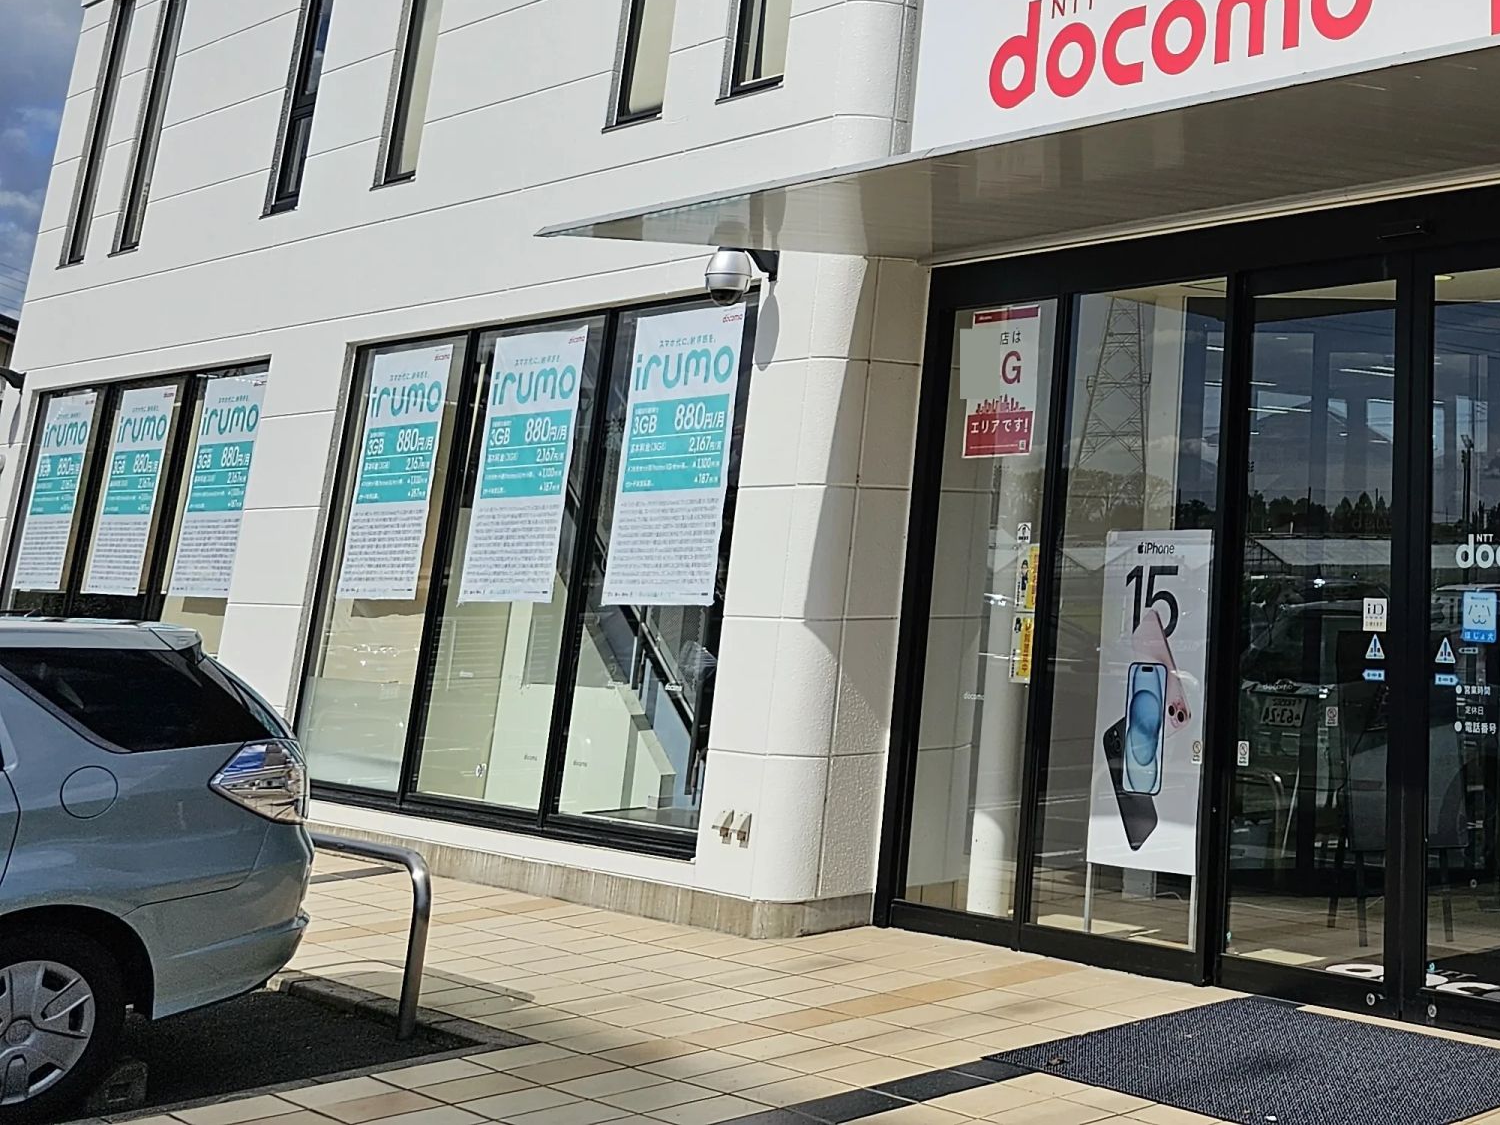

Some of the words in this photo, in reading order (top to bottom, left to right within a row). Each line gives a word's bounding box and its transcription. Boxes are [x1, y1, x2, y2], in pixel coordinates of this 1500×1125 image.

[635, 345, 734, 391] irumo
[492, 365, 576, 405] irumo
[371, 380, 442, 417] irumo
[117, 415, 167, 443] irumo
[201, 404, 259, 435] irumo
[633, 415, 657, 434] 3GB
[674, 402, 725, 431] 880円/月
[43, 421, 87, 447] irumo
[525, 417, 567, 443] 880円/月
[367, 438, 384, 455] 3GB
[1144, 542, 1175, 554] iPhone
[1476, 534, 1494, 543] NTT
[1126, 566, 1178, 638] 15
[1367, 603, 1384, 615] iD
[1464, 686, 1491, 696] 営業時間
[1465, 706, 1484, 715] 定休日
[1465, 722, 1497, 734] 電話番号
